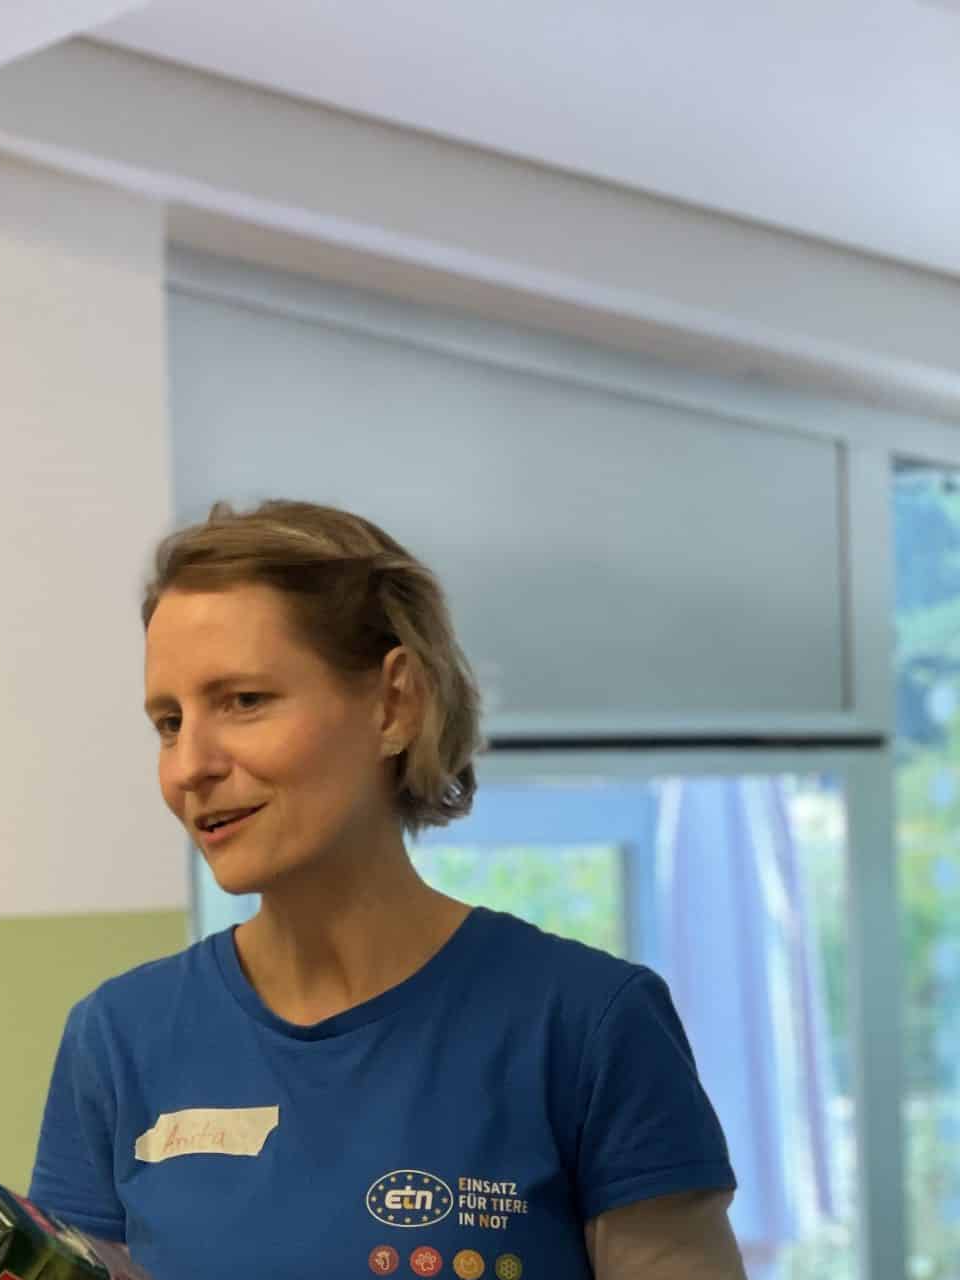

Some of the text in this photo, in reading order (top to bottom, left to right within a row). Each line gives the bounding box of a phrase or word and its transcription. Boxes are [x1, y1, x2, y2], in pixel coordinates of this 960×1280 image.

[458, 1177, 518, 1196] EINSATZ
[458, 1194, 529, 1214] FÜR TIERE
[458, 1212, 509, 1230] IN NOT
